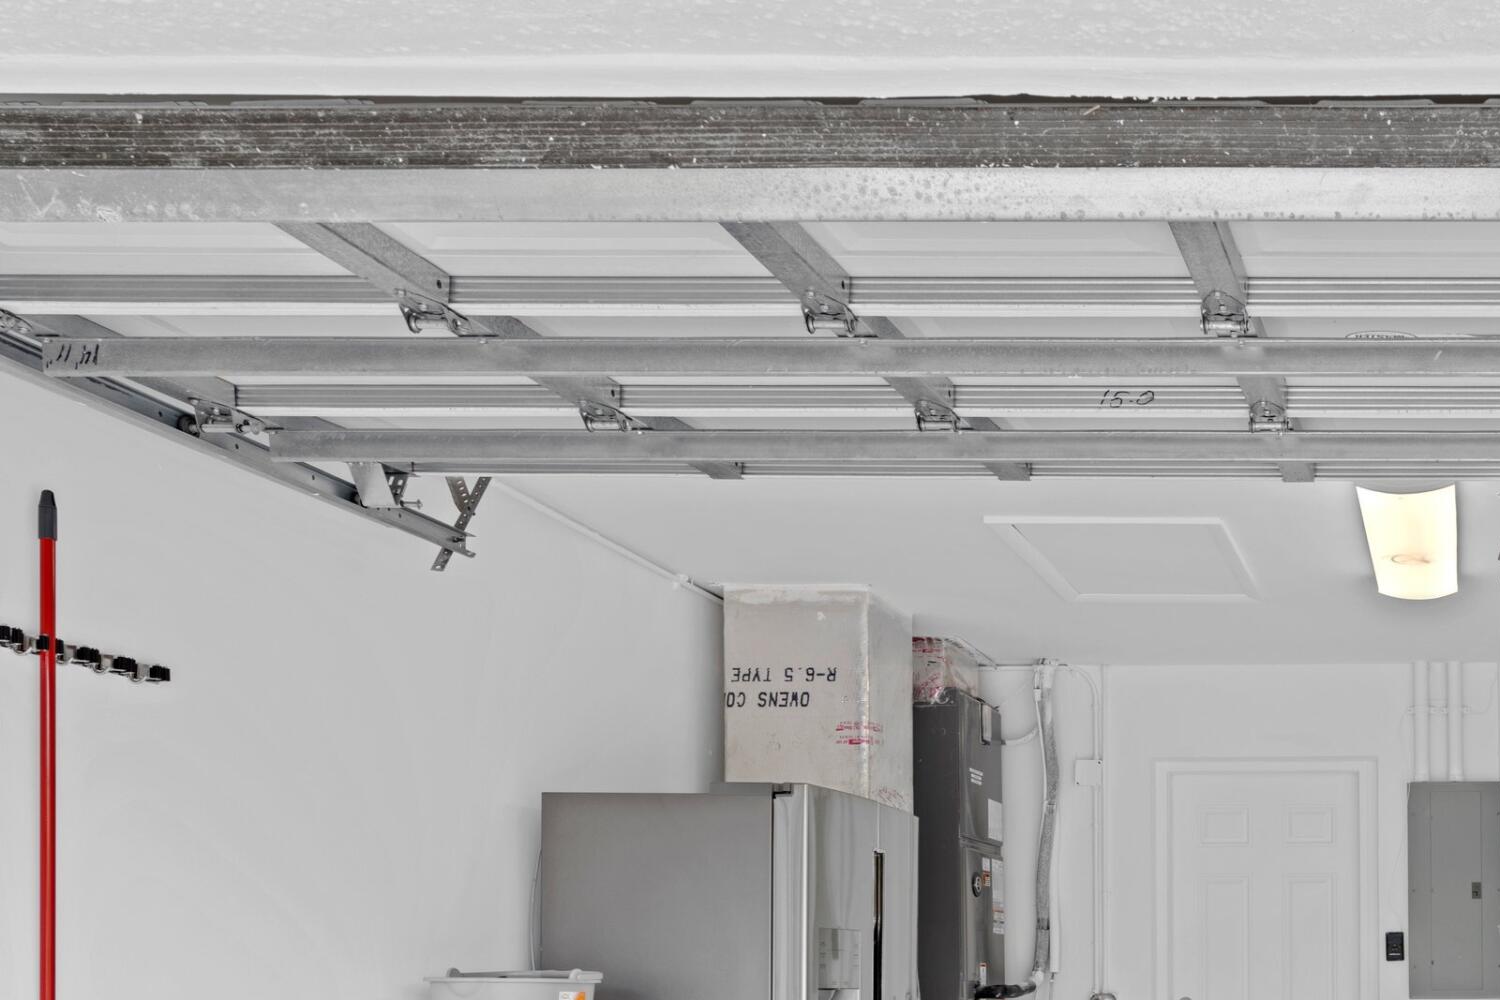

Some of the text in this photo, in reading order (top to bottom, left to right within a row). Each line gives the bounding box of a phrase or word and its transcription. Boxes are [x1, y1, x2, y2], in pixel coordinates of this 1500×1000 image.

[731, 667, 838, 683] R-6.5 TYPE
[757, 691, 811, 708] OWENS
